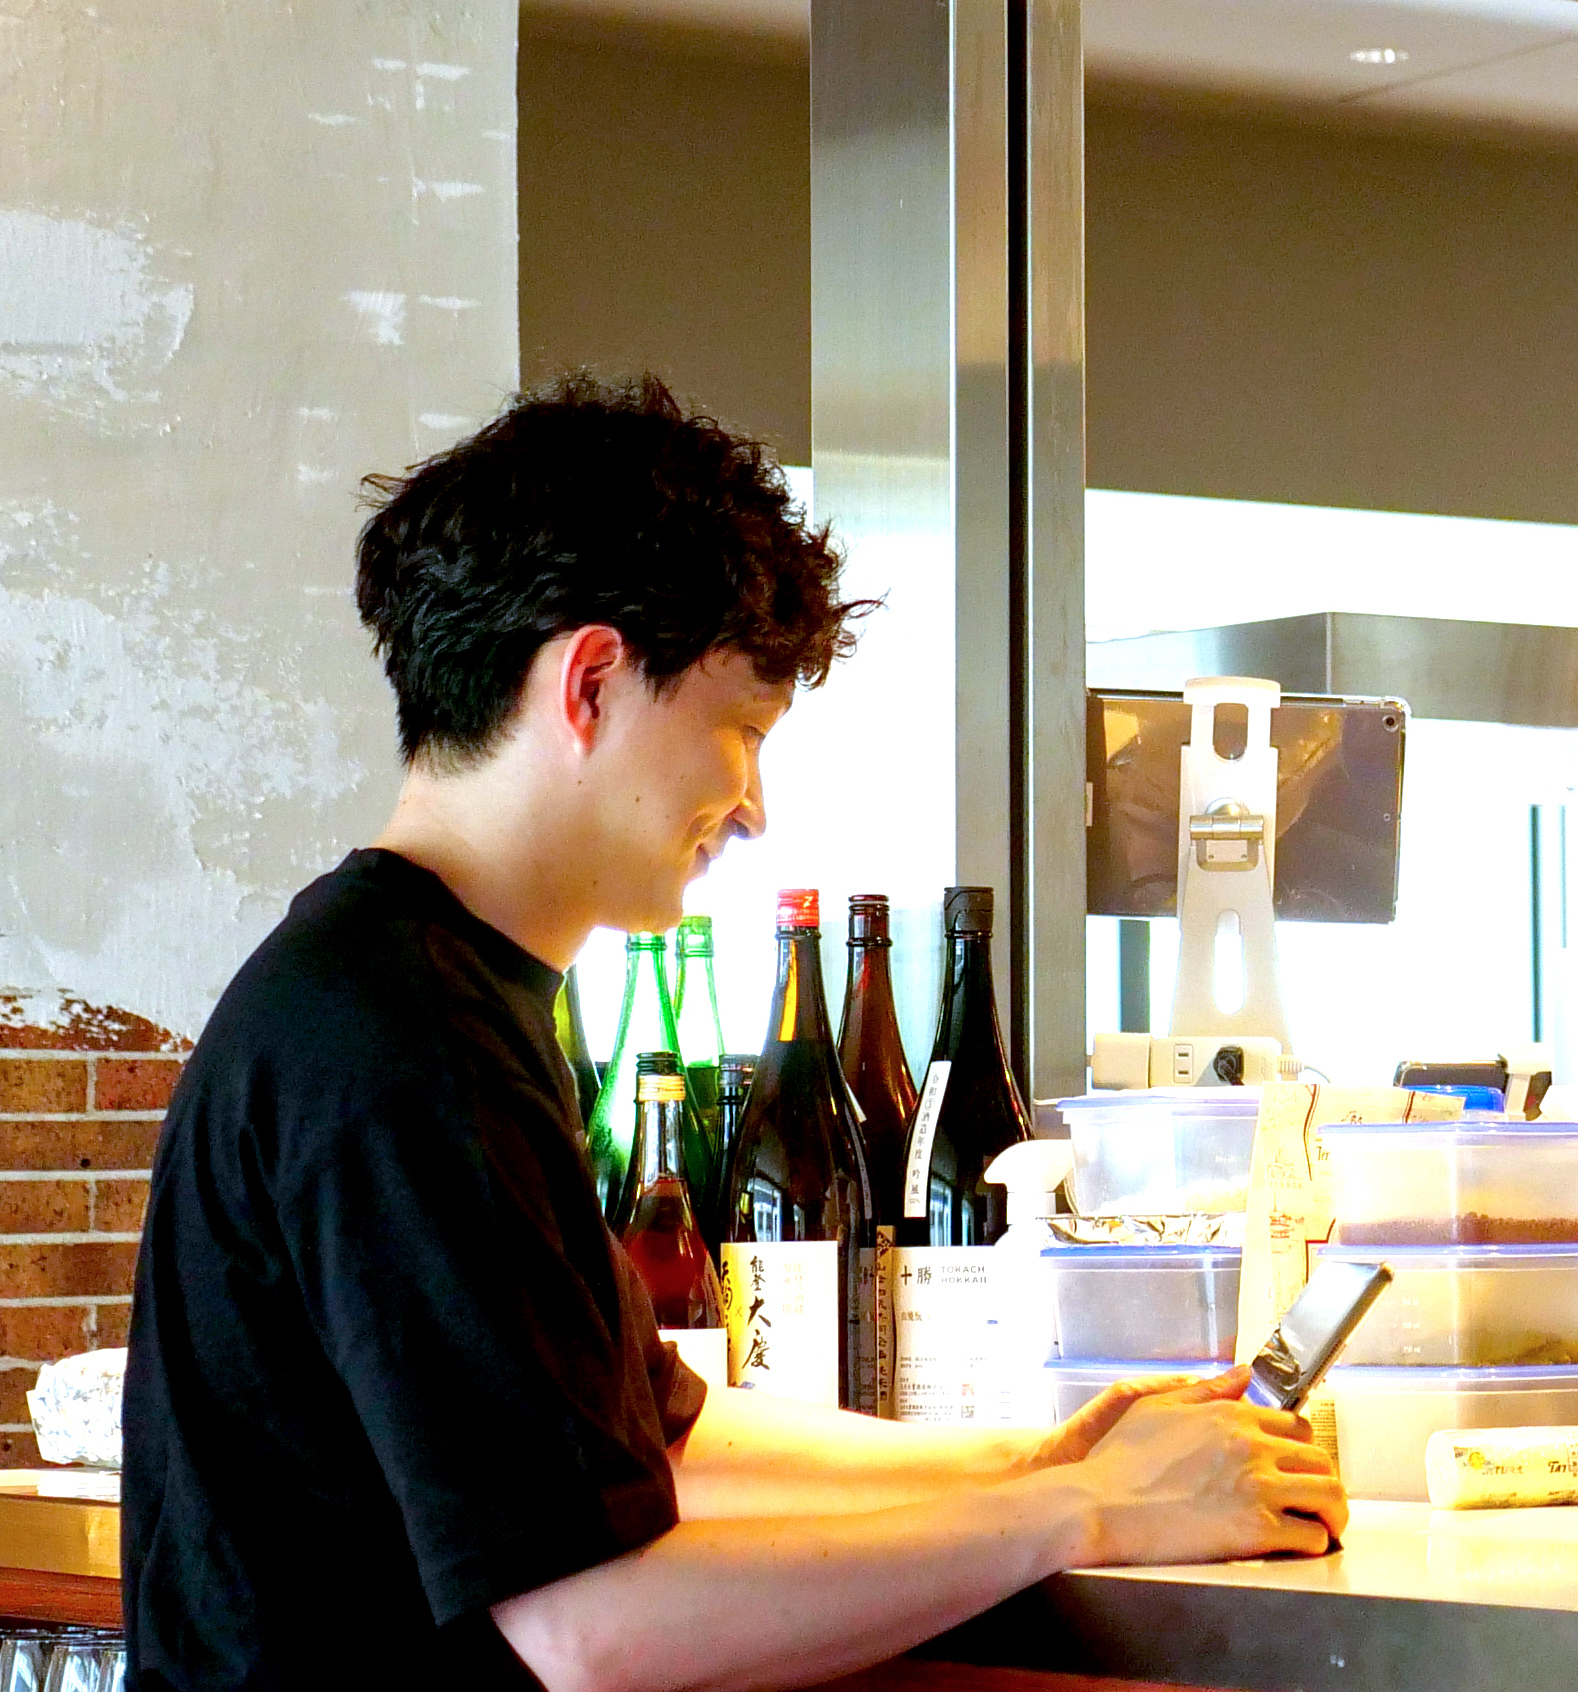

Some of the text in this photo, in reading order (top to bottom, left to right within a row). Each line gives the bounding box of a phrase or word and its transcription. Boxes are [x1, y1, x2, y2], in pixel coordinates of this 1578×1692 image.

[941, 1265, 985, 1274] TOKACH
[900, 1265, 932, 1286] 十勝
[941, 1276, 987, 1284] HOKKAI
